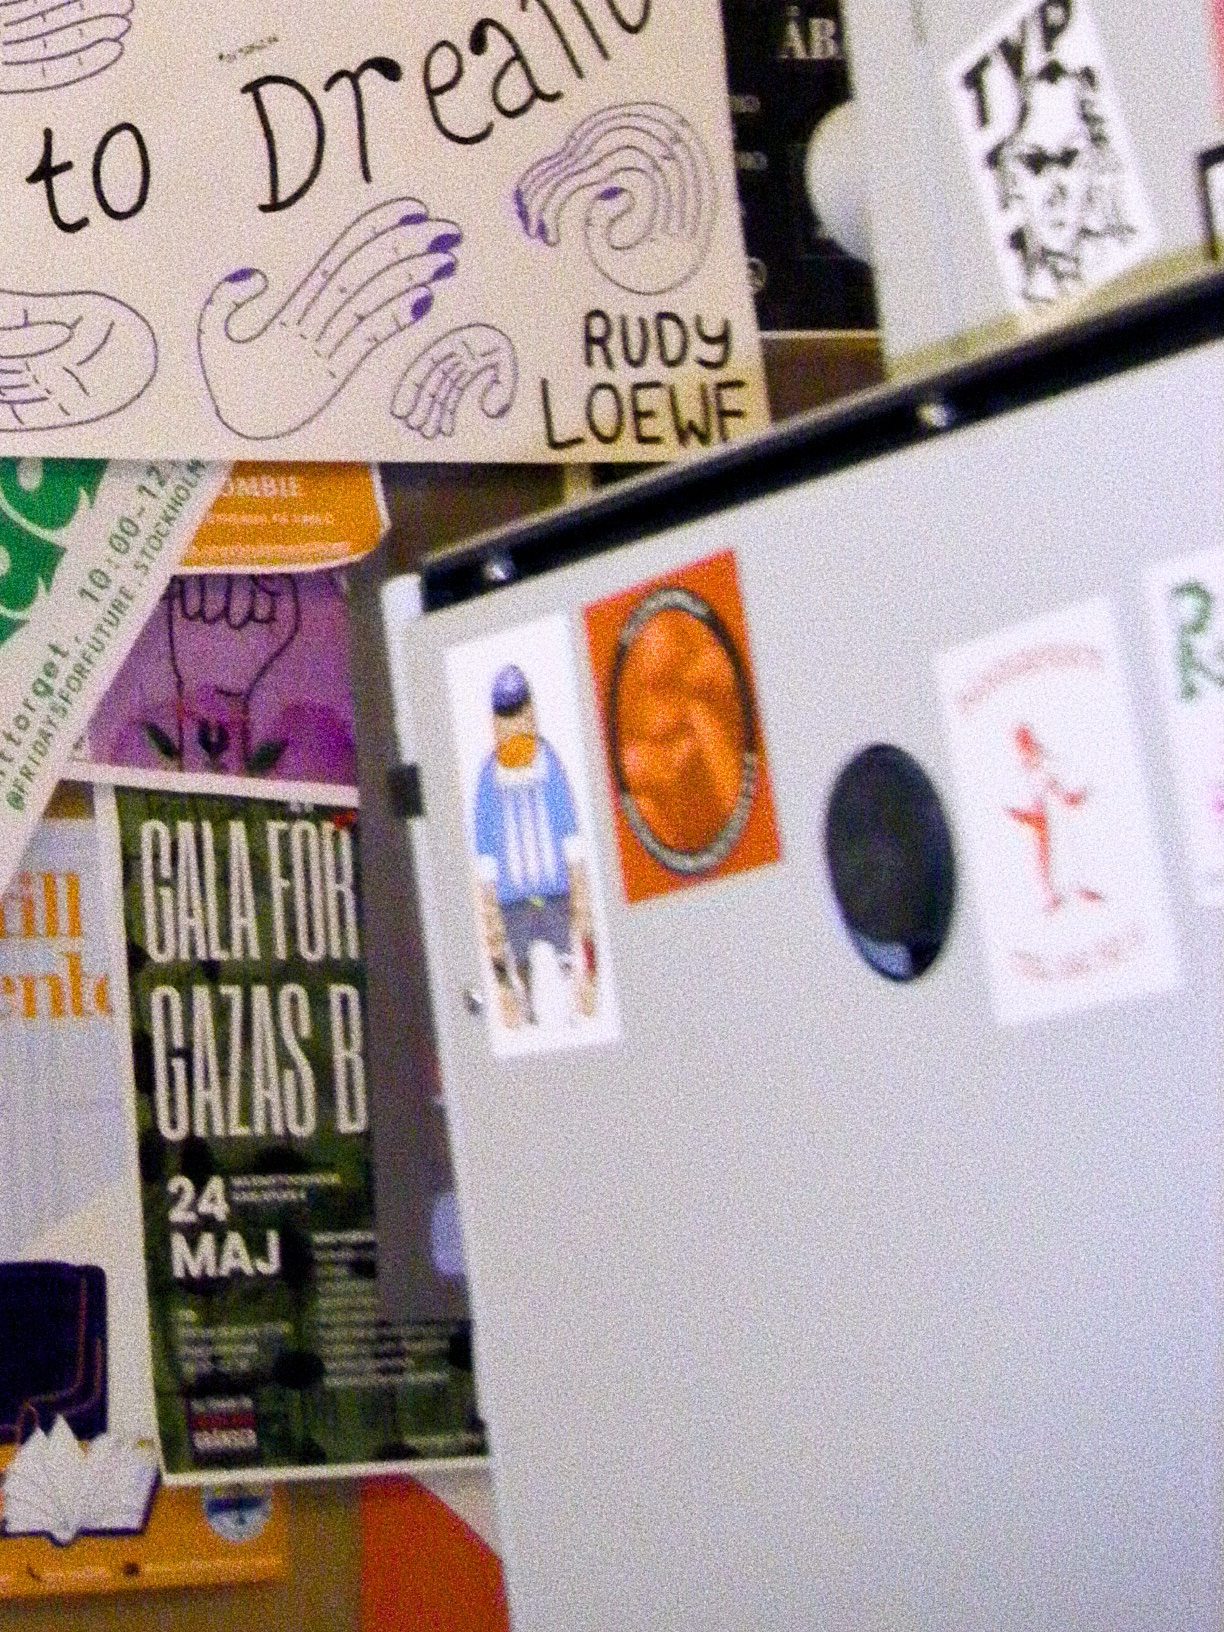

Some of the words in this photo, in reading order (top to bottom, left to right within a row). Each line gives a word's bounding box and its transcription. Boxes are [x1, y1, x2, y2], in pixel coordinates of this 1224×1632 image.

[26, 120, 150, 234] to
[141, 819, 261, 962] GALA
[150, 982, 317, 1142] GAZAS
[167, 1174, 229, 1224] 24
[170, 1229, 282, 1279] MAJ
